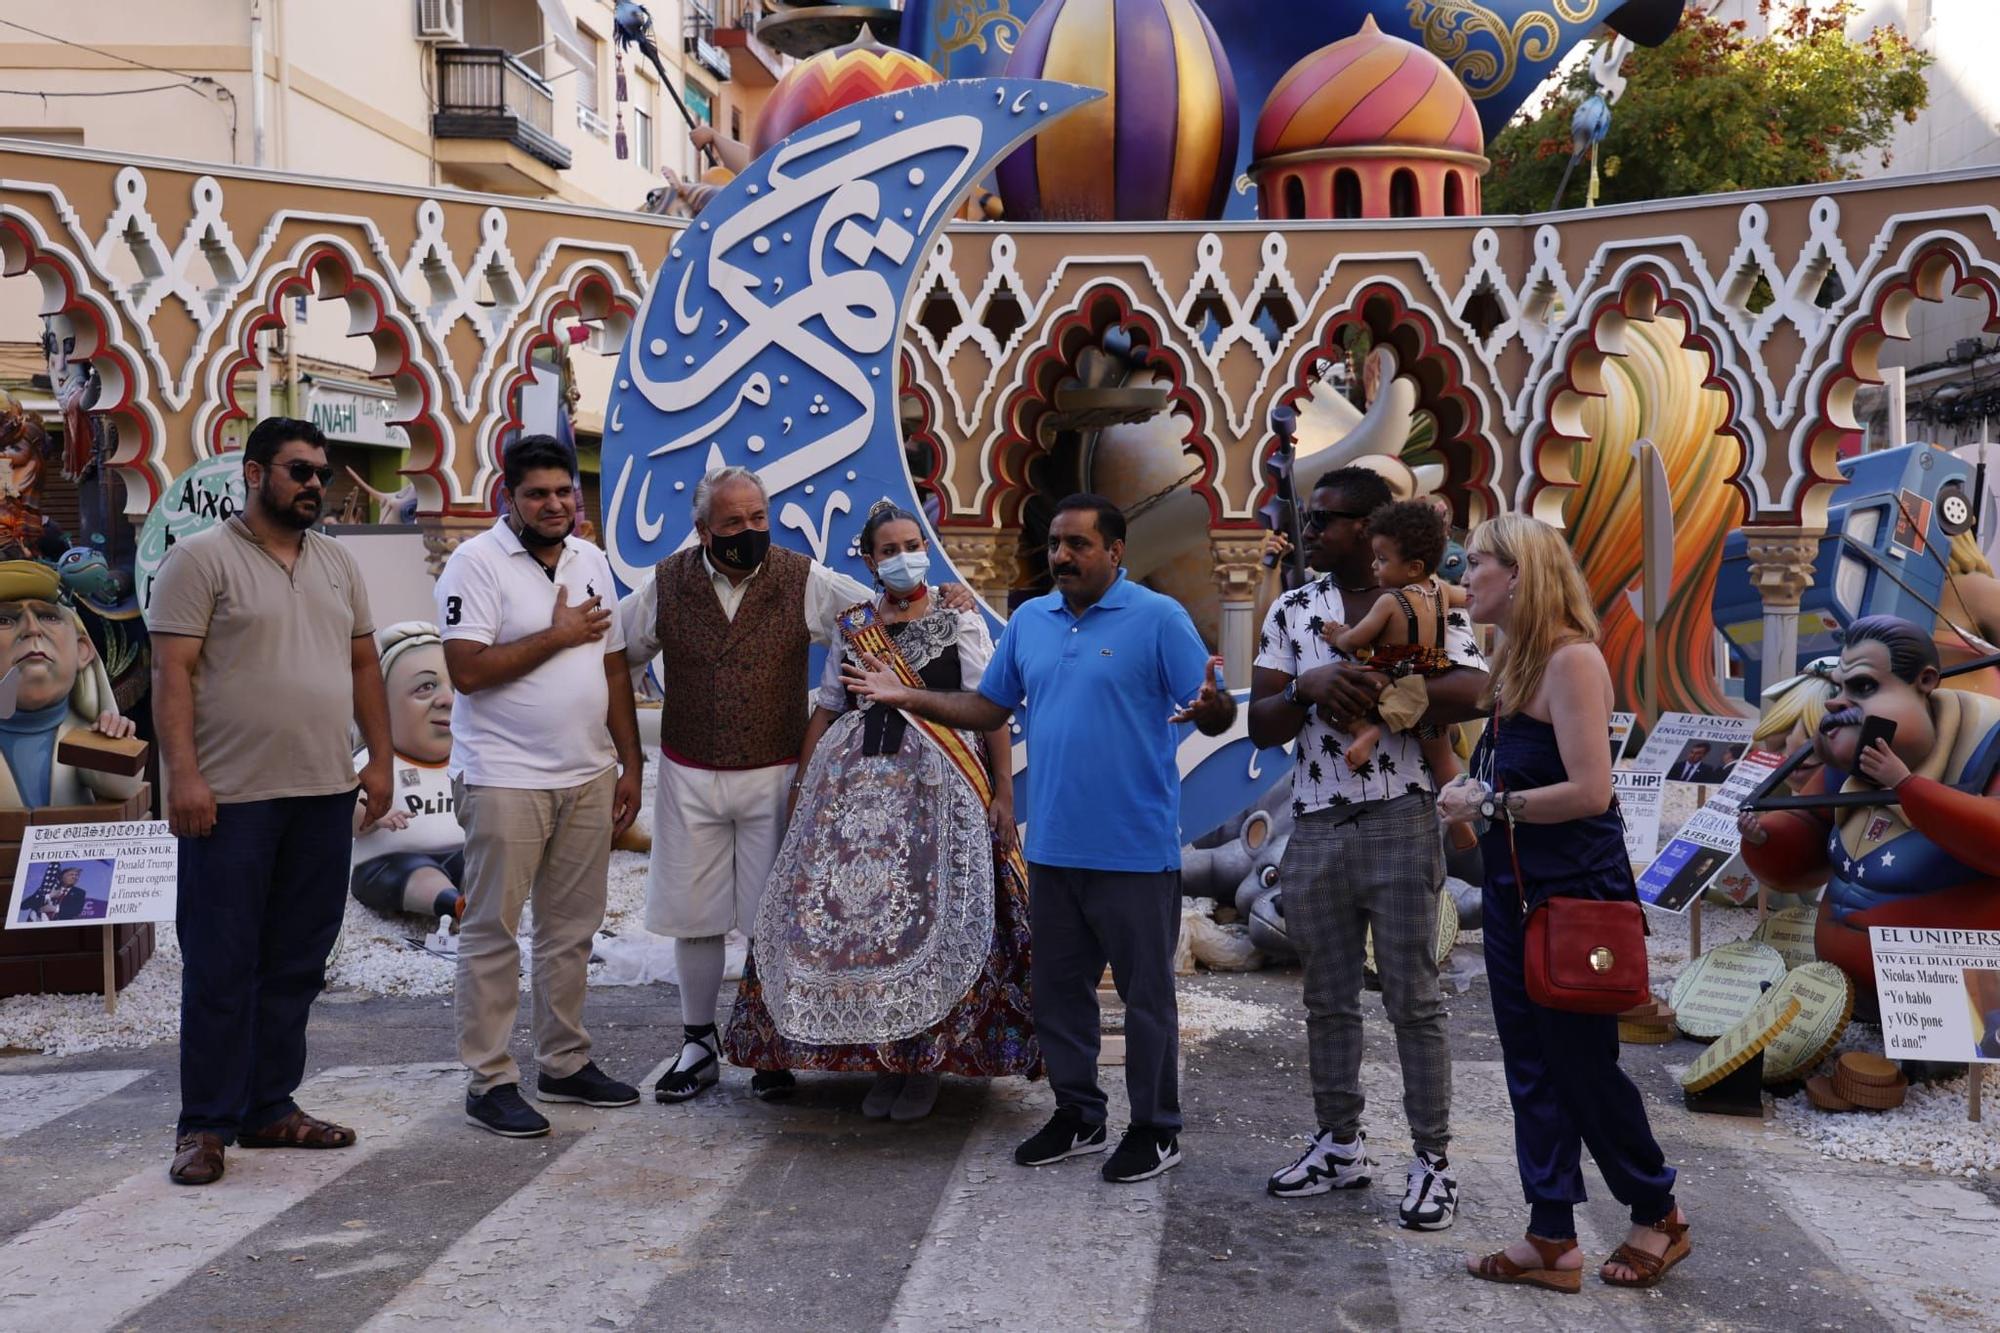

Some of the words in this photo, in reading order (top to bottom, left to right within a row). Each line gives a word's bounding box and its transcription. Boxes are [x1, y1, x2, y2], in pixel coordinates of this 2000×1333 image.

[312, 395, 356, 433] ANAHÍ
[178, 477, 234, 521] Això
[446, 596, 462, 625] 3
[1679, 715, 1693, 724] EL
[1698, 716, 1744, 728] PASTÍS
[1657, 727, 1695, 737] ENVIDE
[1632, 775, 1661, 787] HIP!
[35, 828, 62, 841] THE
[63, 824, 145, 840] GUASINTON
[148, 823, 168, 838] PO
[1691, 831, 1707, 841] FER
[1707, 835, 1718, 843] LA
[30, 852, 46, 860] EM
[47, 850, 80, 860] DIUEN,
[116, 847, 148, 857] JAMES
[117, 859, 146, 870] Donald
[127, 876, 144, 884] meu
[146, 875, 177, 886] cognom
[1881, 929, 1904, 942] EL
[1876, 955, 1906, 965] VIVA
[1909, 956, 1924, 965] EL
[1928, 957, 1984, 967] DIALOGO
[1882, 969, 1915, 983] Nicolas
[1917, 970, 1958, 984] Maduro:
[1906, 991, 1932, 1005] hablo
[1888, 1014, 1894, 1029] y
[1895, 1012, 1918, 1026] VOS
[1921, 1016, 1943, 1030] pone
[1891, 1034, 1899, 1048] el
